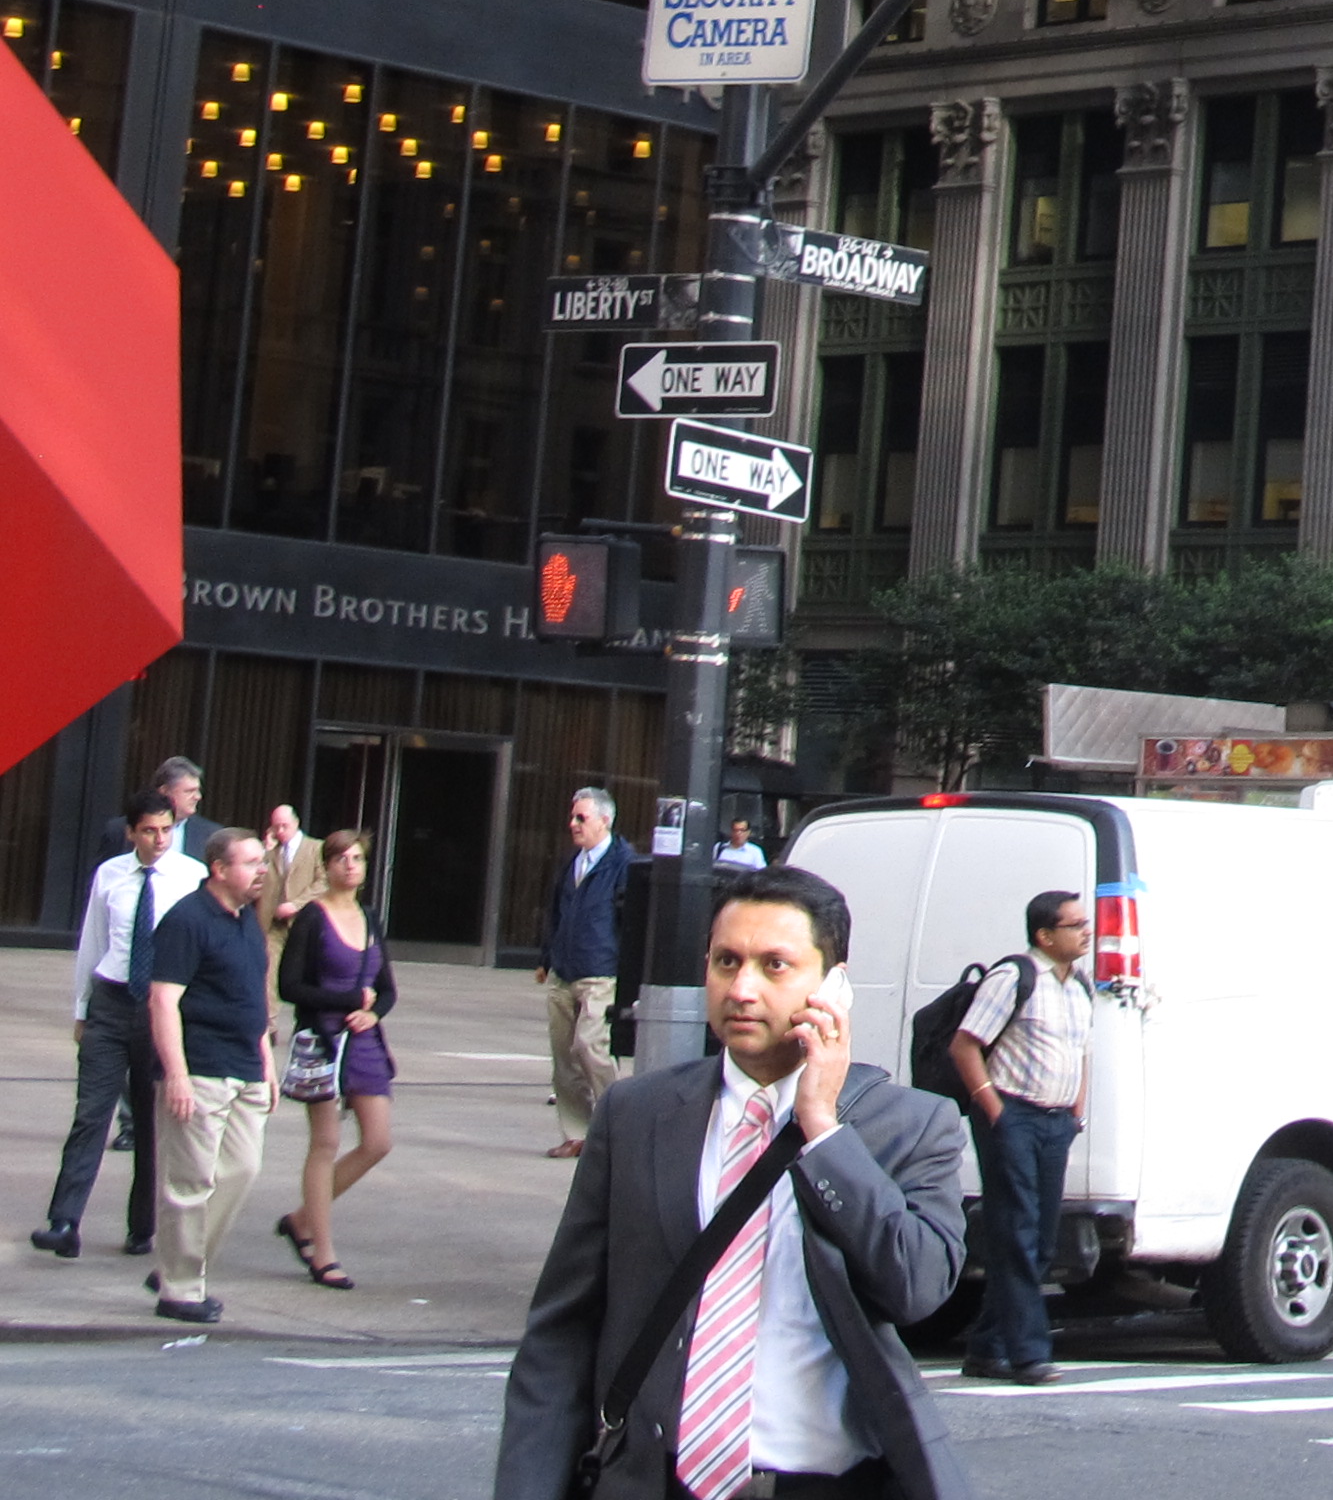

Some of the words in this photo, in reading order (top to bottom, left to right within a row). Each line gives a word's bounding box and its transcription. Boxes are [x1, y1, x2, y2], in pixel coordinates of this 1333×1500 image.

[667, 11, 789, 49] CAMERA
[700, 52, 714, 67] IN
[716, 51, 752, 67] AREA
[800, 243, 924, 294] BROADWAY
[552, 290, 640, 320] LIBERTY
[640, 289, 655, 306] ST
[661, 366, 703, 393] ONE
[715, 365, 761, 393] WAY
[691, 448, 731, 482] ONE
[751, 461, 790, 494] WAY
[184, 570, 299, 615] ROWN
[313, 584, 490, 635] BROTHERS
